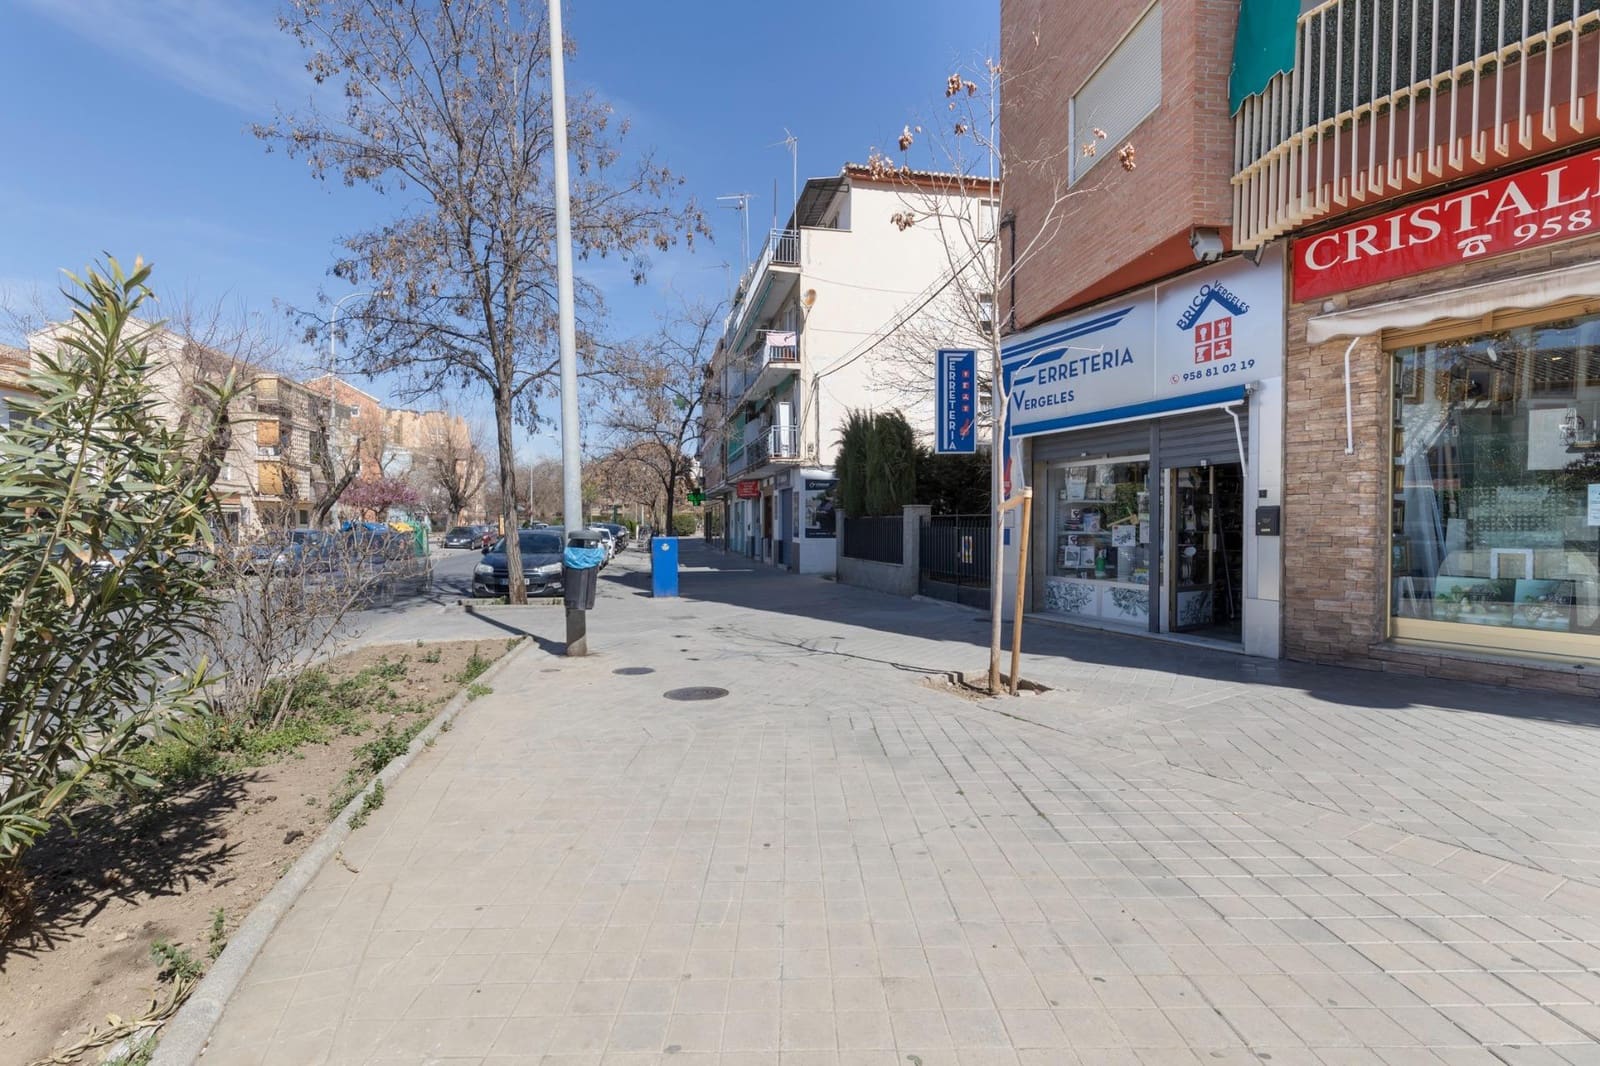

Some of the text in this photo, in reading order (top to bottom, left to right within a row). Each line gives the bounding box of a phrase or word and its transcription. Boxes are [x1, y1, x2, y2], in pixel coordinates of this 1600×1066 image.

[1513, 209, 1592, 246] 958
[1176, 284, 1211, 331] BRICO
[1213, 280, 1250, 313] VERGELES
[1183, 359, 1255, 382] 958 81 02 19
[1012, 389, 1075, 412] VERGELES
